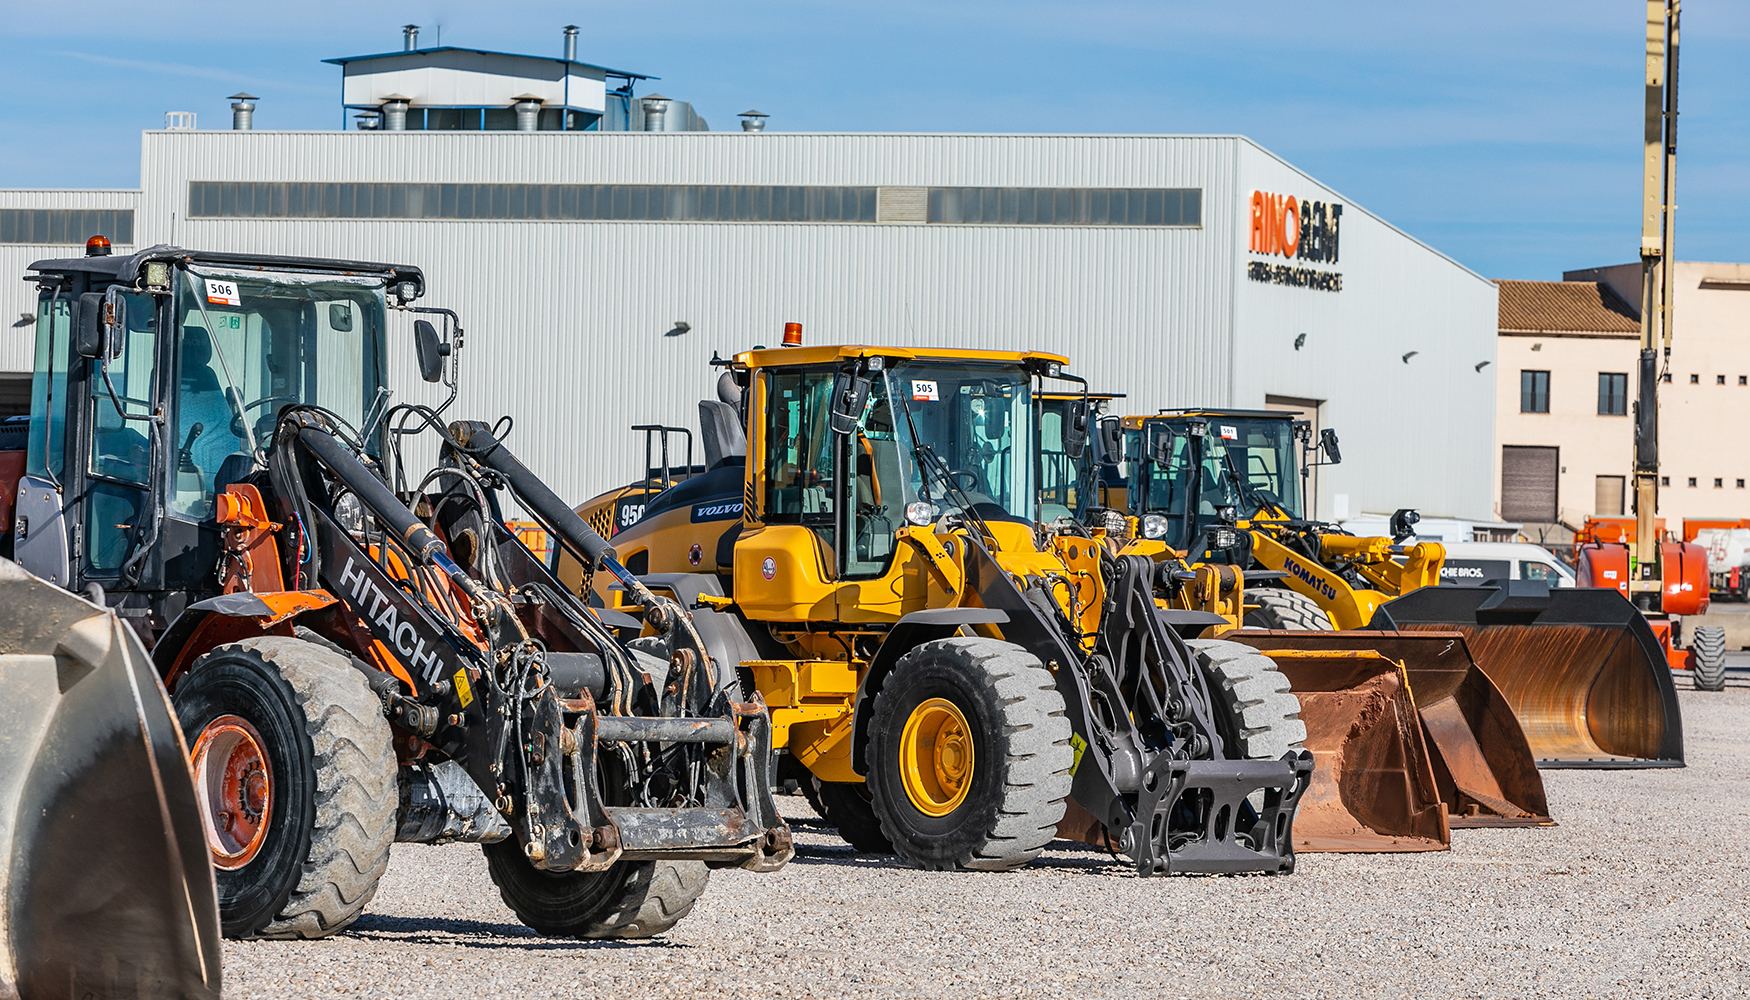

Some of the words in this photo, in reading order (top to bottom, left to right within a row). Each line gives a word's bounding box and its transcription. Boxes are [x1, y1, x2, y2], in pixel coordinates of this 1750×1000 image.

[210, 283, 232, 296] 506
[915, 383, 933, 393] 505
[697, 502, 744, 517] VOLVO
[1283, 556, 1337, 601] KOMATSU
[1440, 567, 1458, 578] CHIE
[1458, 567, 1485, 579] BROS.
[339, 556, 445, 687] HITACHI
